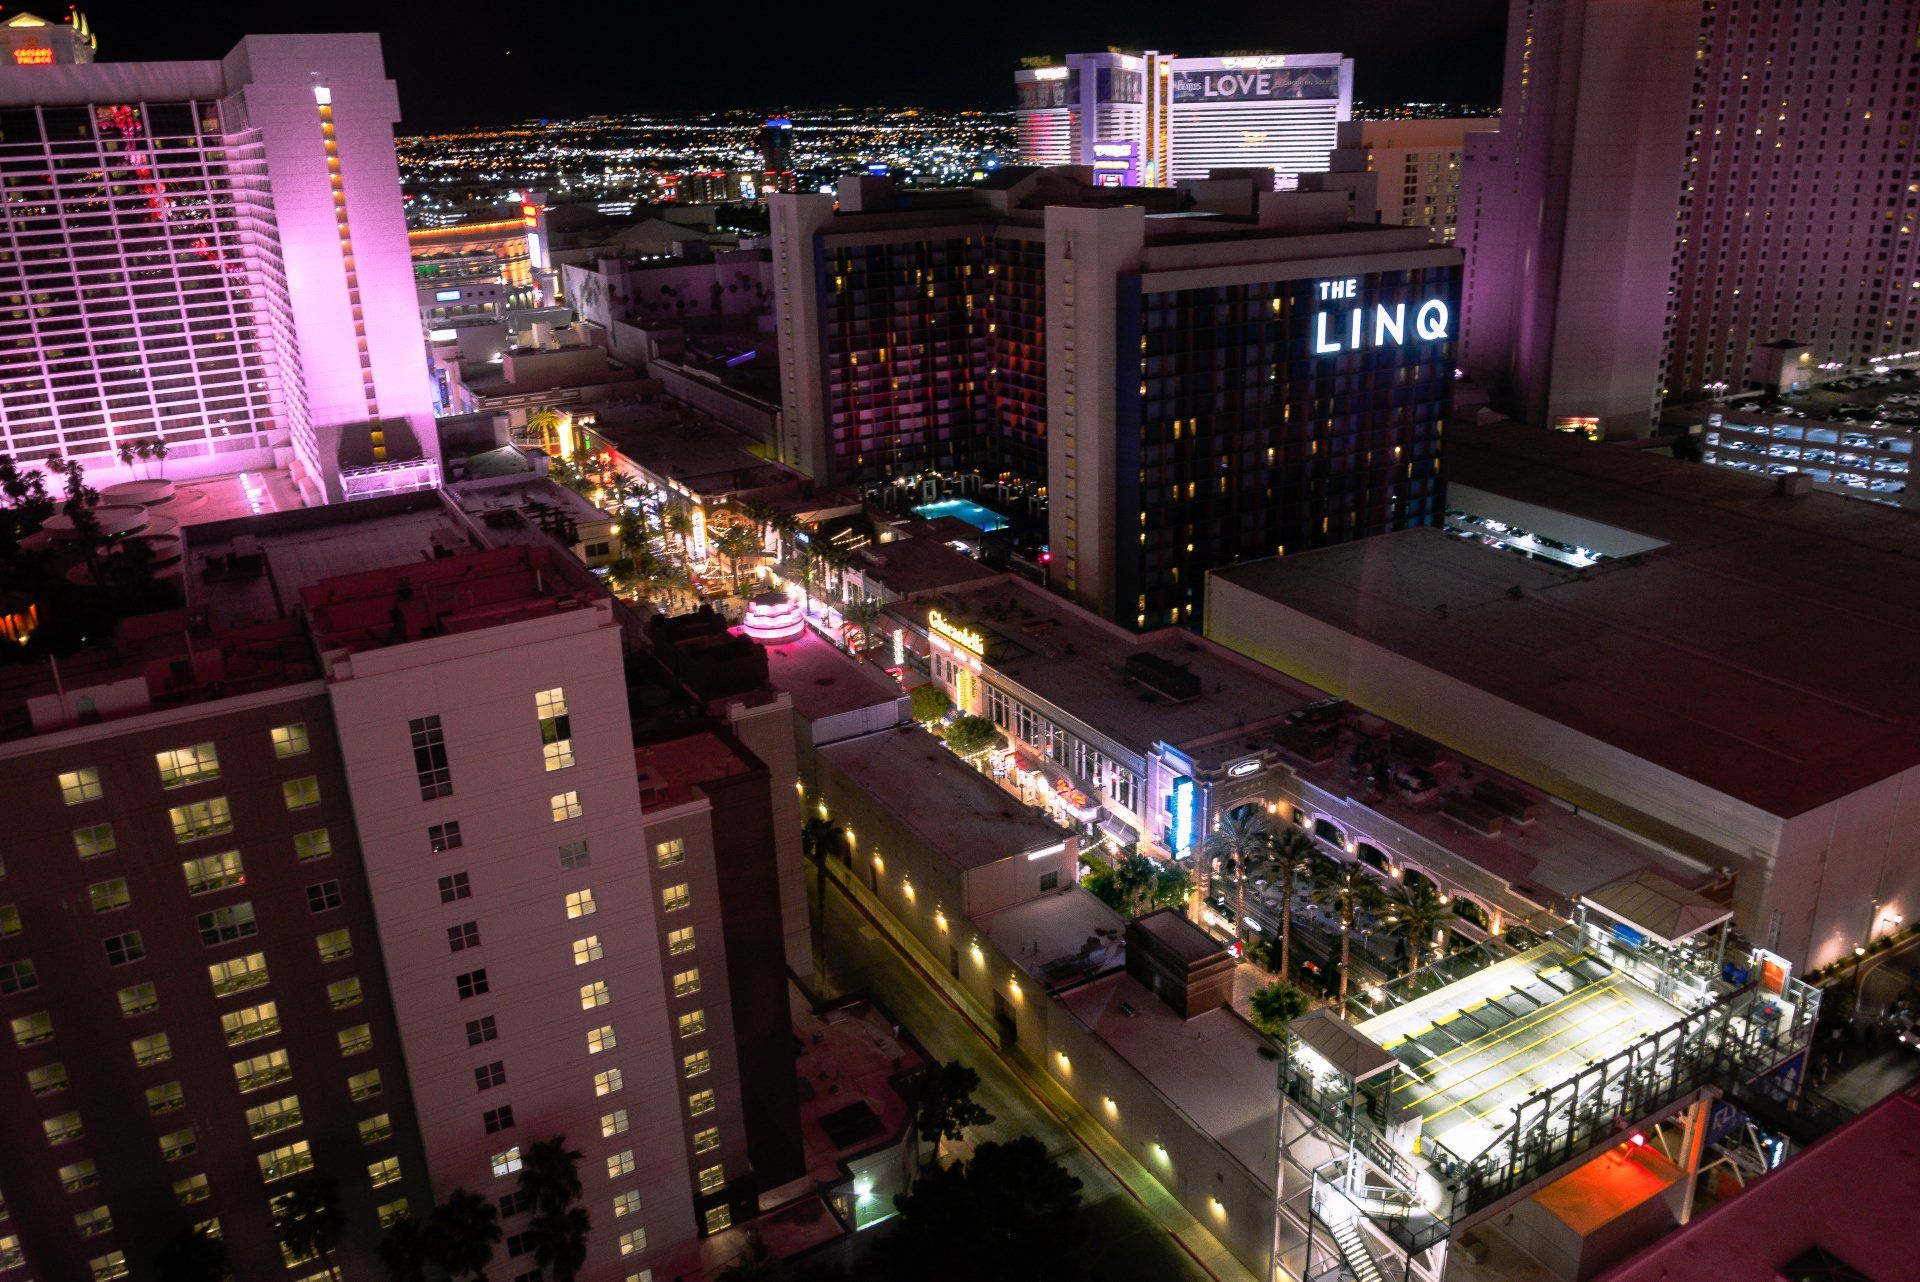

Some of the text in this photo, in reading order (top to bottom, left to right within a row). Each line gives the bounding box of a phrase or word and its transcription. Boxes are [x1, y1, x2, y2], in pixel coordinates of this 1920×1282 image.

[1203, 74, 1271, 96] LOVE
[1319, 279, 1357, 300] THE
[1316, 299, 1449, 354] LINQ
